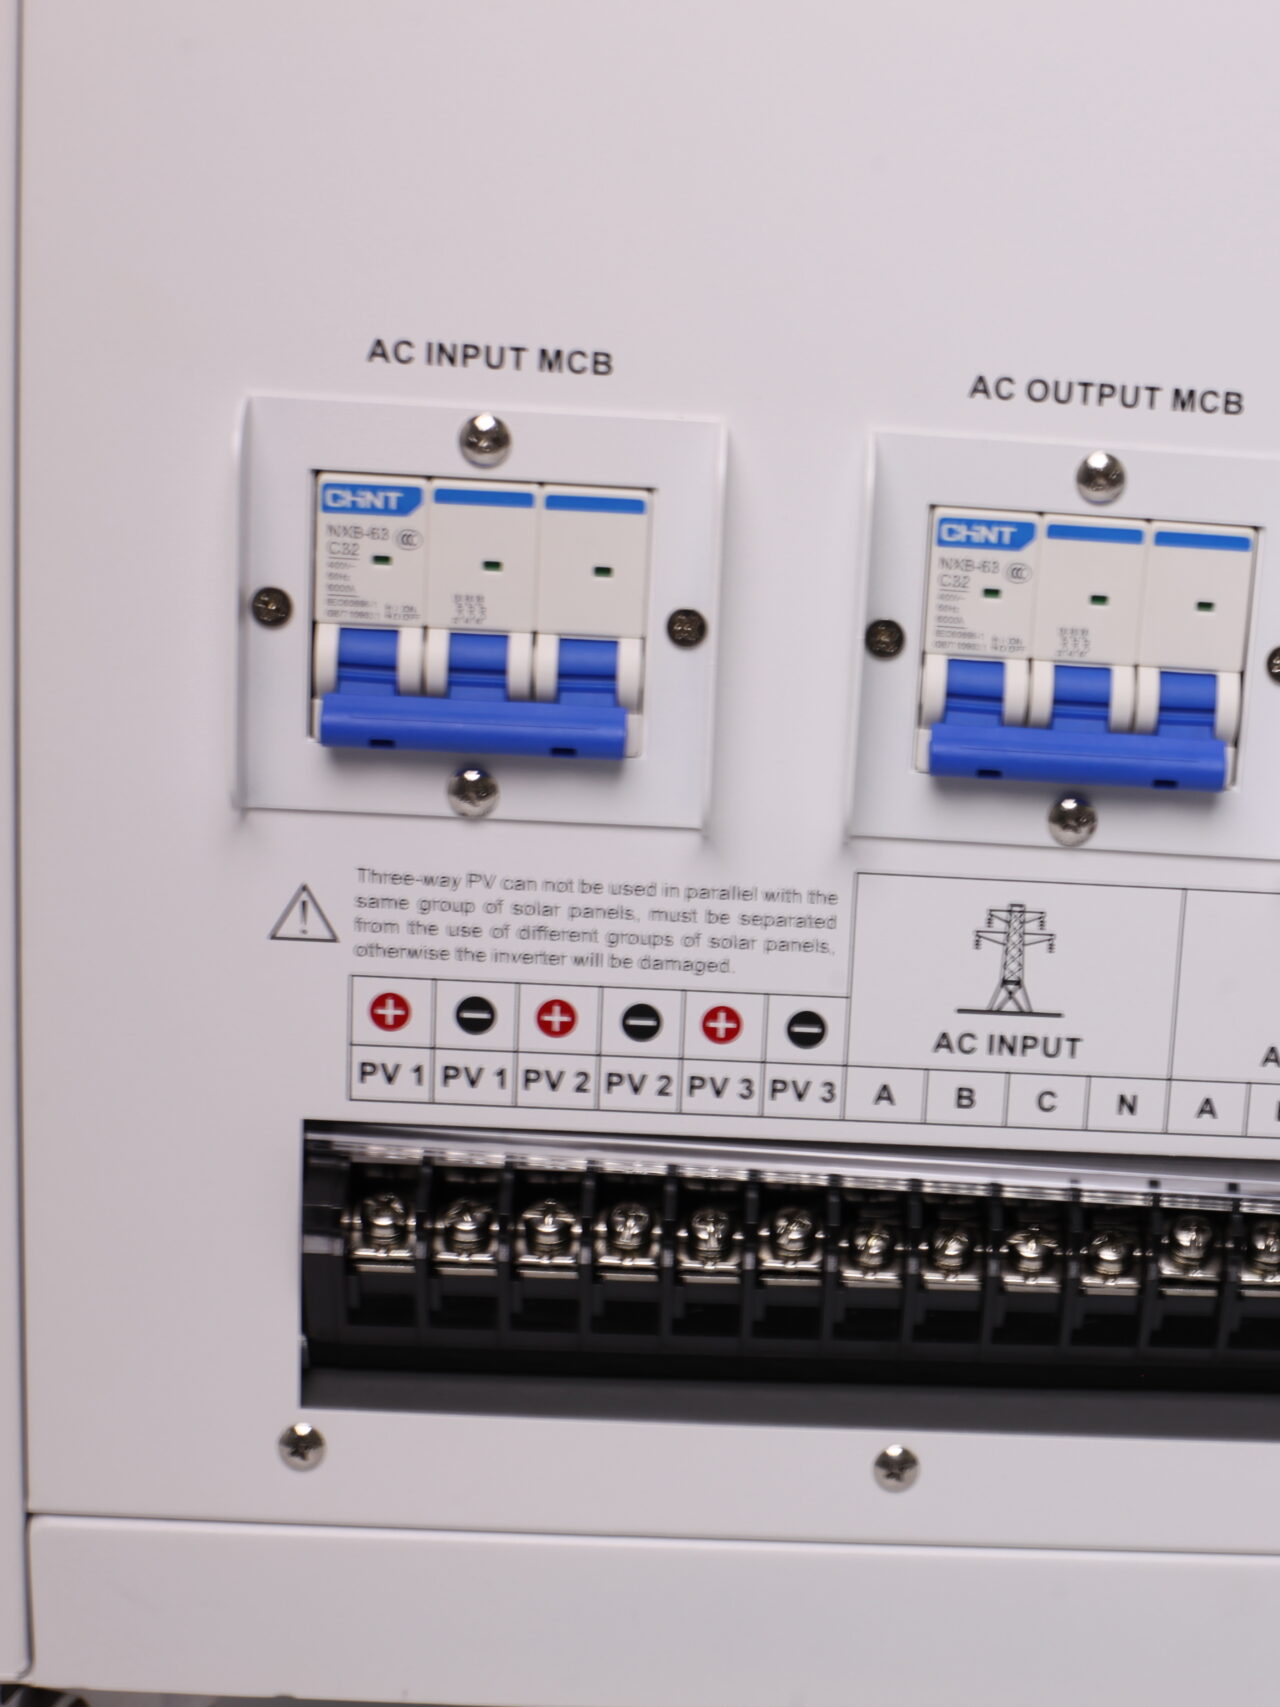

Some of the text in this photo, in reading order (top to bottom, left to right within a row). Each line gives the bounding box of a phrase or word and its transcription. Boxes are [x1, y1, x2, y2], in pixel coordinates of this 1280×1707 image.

[367, 338, 613, 376] AC INPUT MCB
[969, 375, 1244, 416] AC OUTPUT MCB
[326, 523, 389, 541] NXB-63
[328, 541, 360, 556] C32
[938, 556, 1000, 574] NXB-63
[938, 574, 970, 589] C32
[356, 867, 839, 906] Three-way PV can not be used in parallel with the
[355, 897, 837, 931] same group of solar panels, must be separated
[354, 917, 836, 957] from the use of different groups of solar panels,
[354, 944, 736, 976] otherwise the inverter will be damaged.
[933, 1031, 1083, 1061] AC INPUT
[359, 1061, 424, 1087] PV 1
[441, 1064, 509, 1090] PV 1
[523, 1068, 591, 1094] PV 2
[606, 1071, 674, 1097] PV 2
[688, 1074, 756, 1101] PV 3
[770, 1078, 837, 1104] PV 3
[873, 1083, 896, 1107] A
[955, 1086, 976, 1110] B
[1037, 1090, 1057, 1113] C
[1118, 1093, 1138, 1117] N
[1196, 1096, 1218, 1120] A
